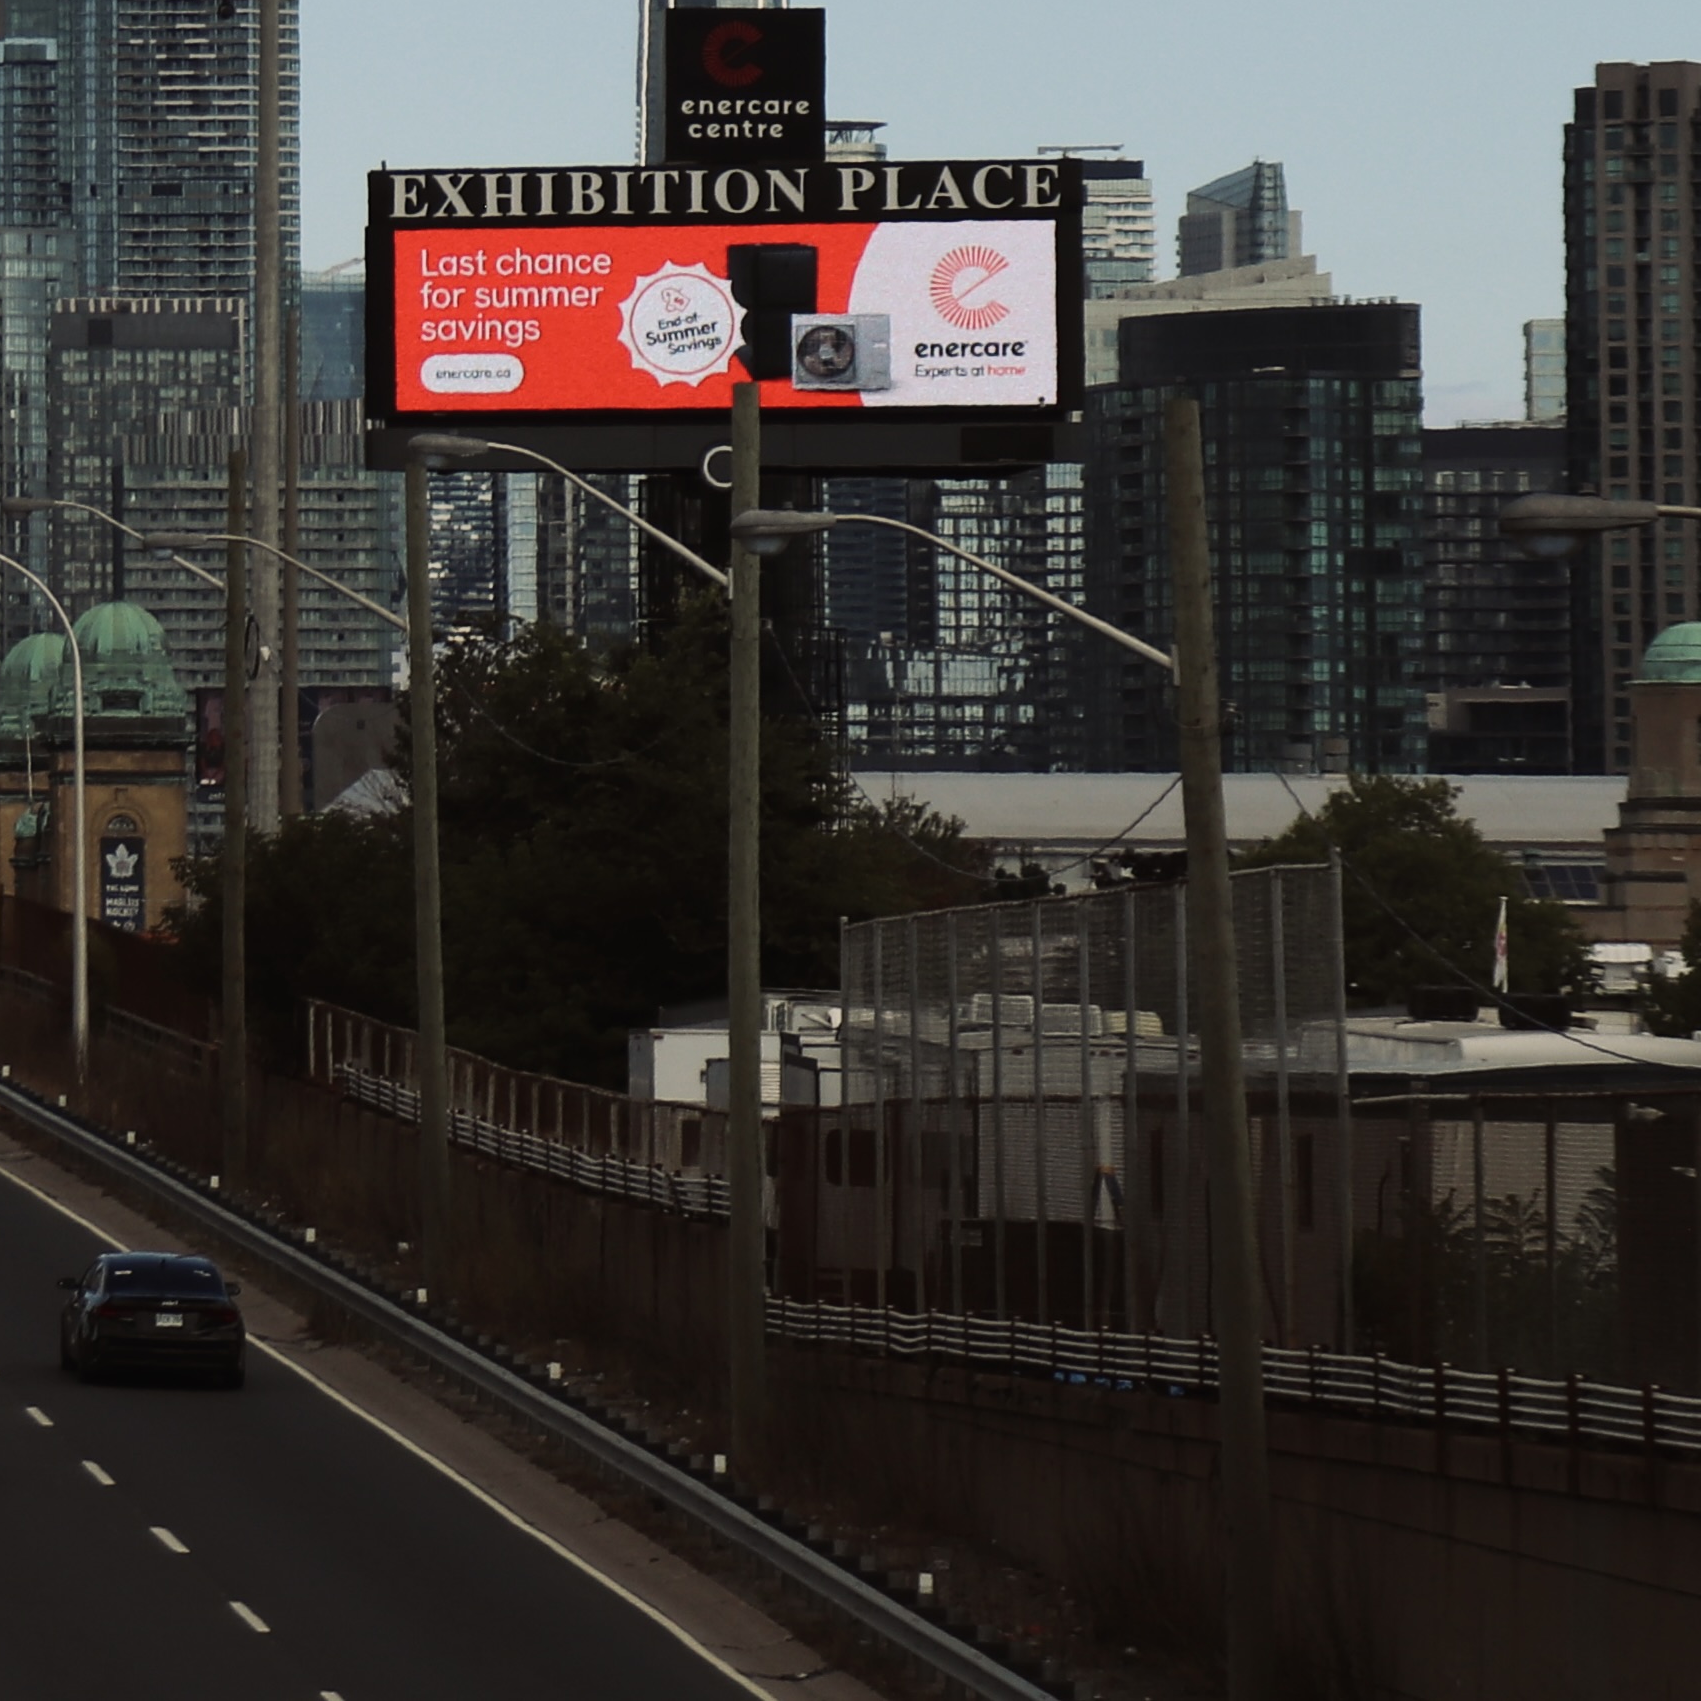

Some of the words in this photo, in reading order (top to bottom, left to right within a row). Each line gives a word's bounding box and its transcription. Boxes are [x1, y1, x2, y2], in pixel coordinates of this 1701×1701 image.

[680, 99, 810, 115] enercare
[687, 120, 784, 138] centre
[389, 168, 809, 218] EXHIBITION
[837, 164, 1062, 212] PLACE
[421, 249, 487, 277] Last
[495, 247, 612, 276] chance
[420, 281, 466, 309] for
[474, 284, 604, 309] summer
[420, 312, 541, 348] savings
[645, 320, 719, 347] Summer
[667, 336, 723, 356] Savings
[914, 341, 1025, 358] enercare
[435, 368, 512, 379] enercare.ca
[915, 364, 968, 379] Experts
[970, 365, 985, 377] at
[987, 364, 1026, 376] home
